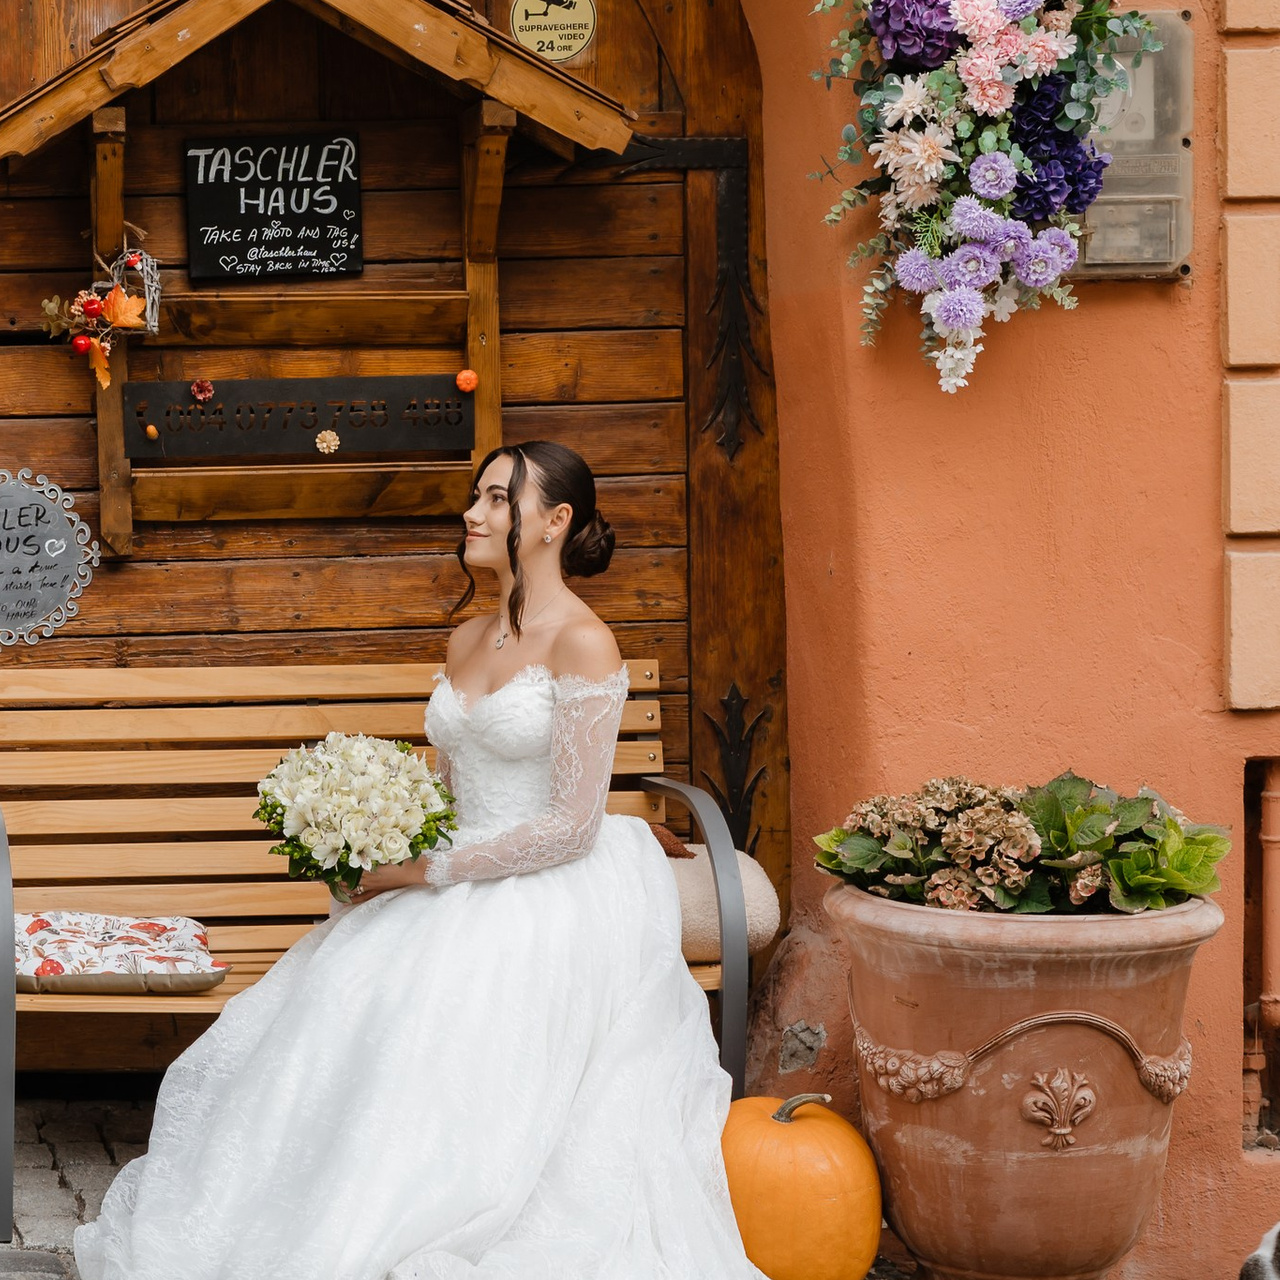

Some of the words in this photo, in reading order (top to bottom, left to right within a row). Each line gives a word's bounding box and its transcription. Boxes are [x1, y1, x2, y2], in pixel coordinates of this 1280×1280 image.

[518, 22, 590, 33] SUPRAVEGHERE
[558, 32, 585, 41] VIDEO
[536, 40, 556, 53] 24
[556, 44, 573, 52] ORE
[187, 137, 358, 184] TASCHLER
[239, 185, 338, 216] HAUS
[199, 226, 242, 245] TAKE
[247, 228, 258, 242] A
[261, 227, 293, 240] PHOTO
[297, 226, 320, 239] AND
[326, 225, 348, 239] TAG
[236, 263, 262, 276] STAY
[267, 260, 293, 272] BACK
[165, 402, 227, 432] 004
[235, 400, 318, 431] 0773
[325, 399, 388, 429] 758
[401, 397, 464, 428] 488
[3, 581, 32, 593] starts
